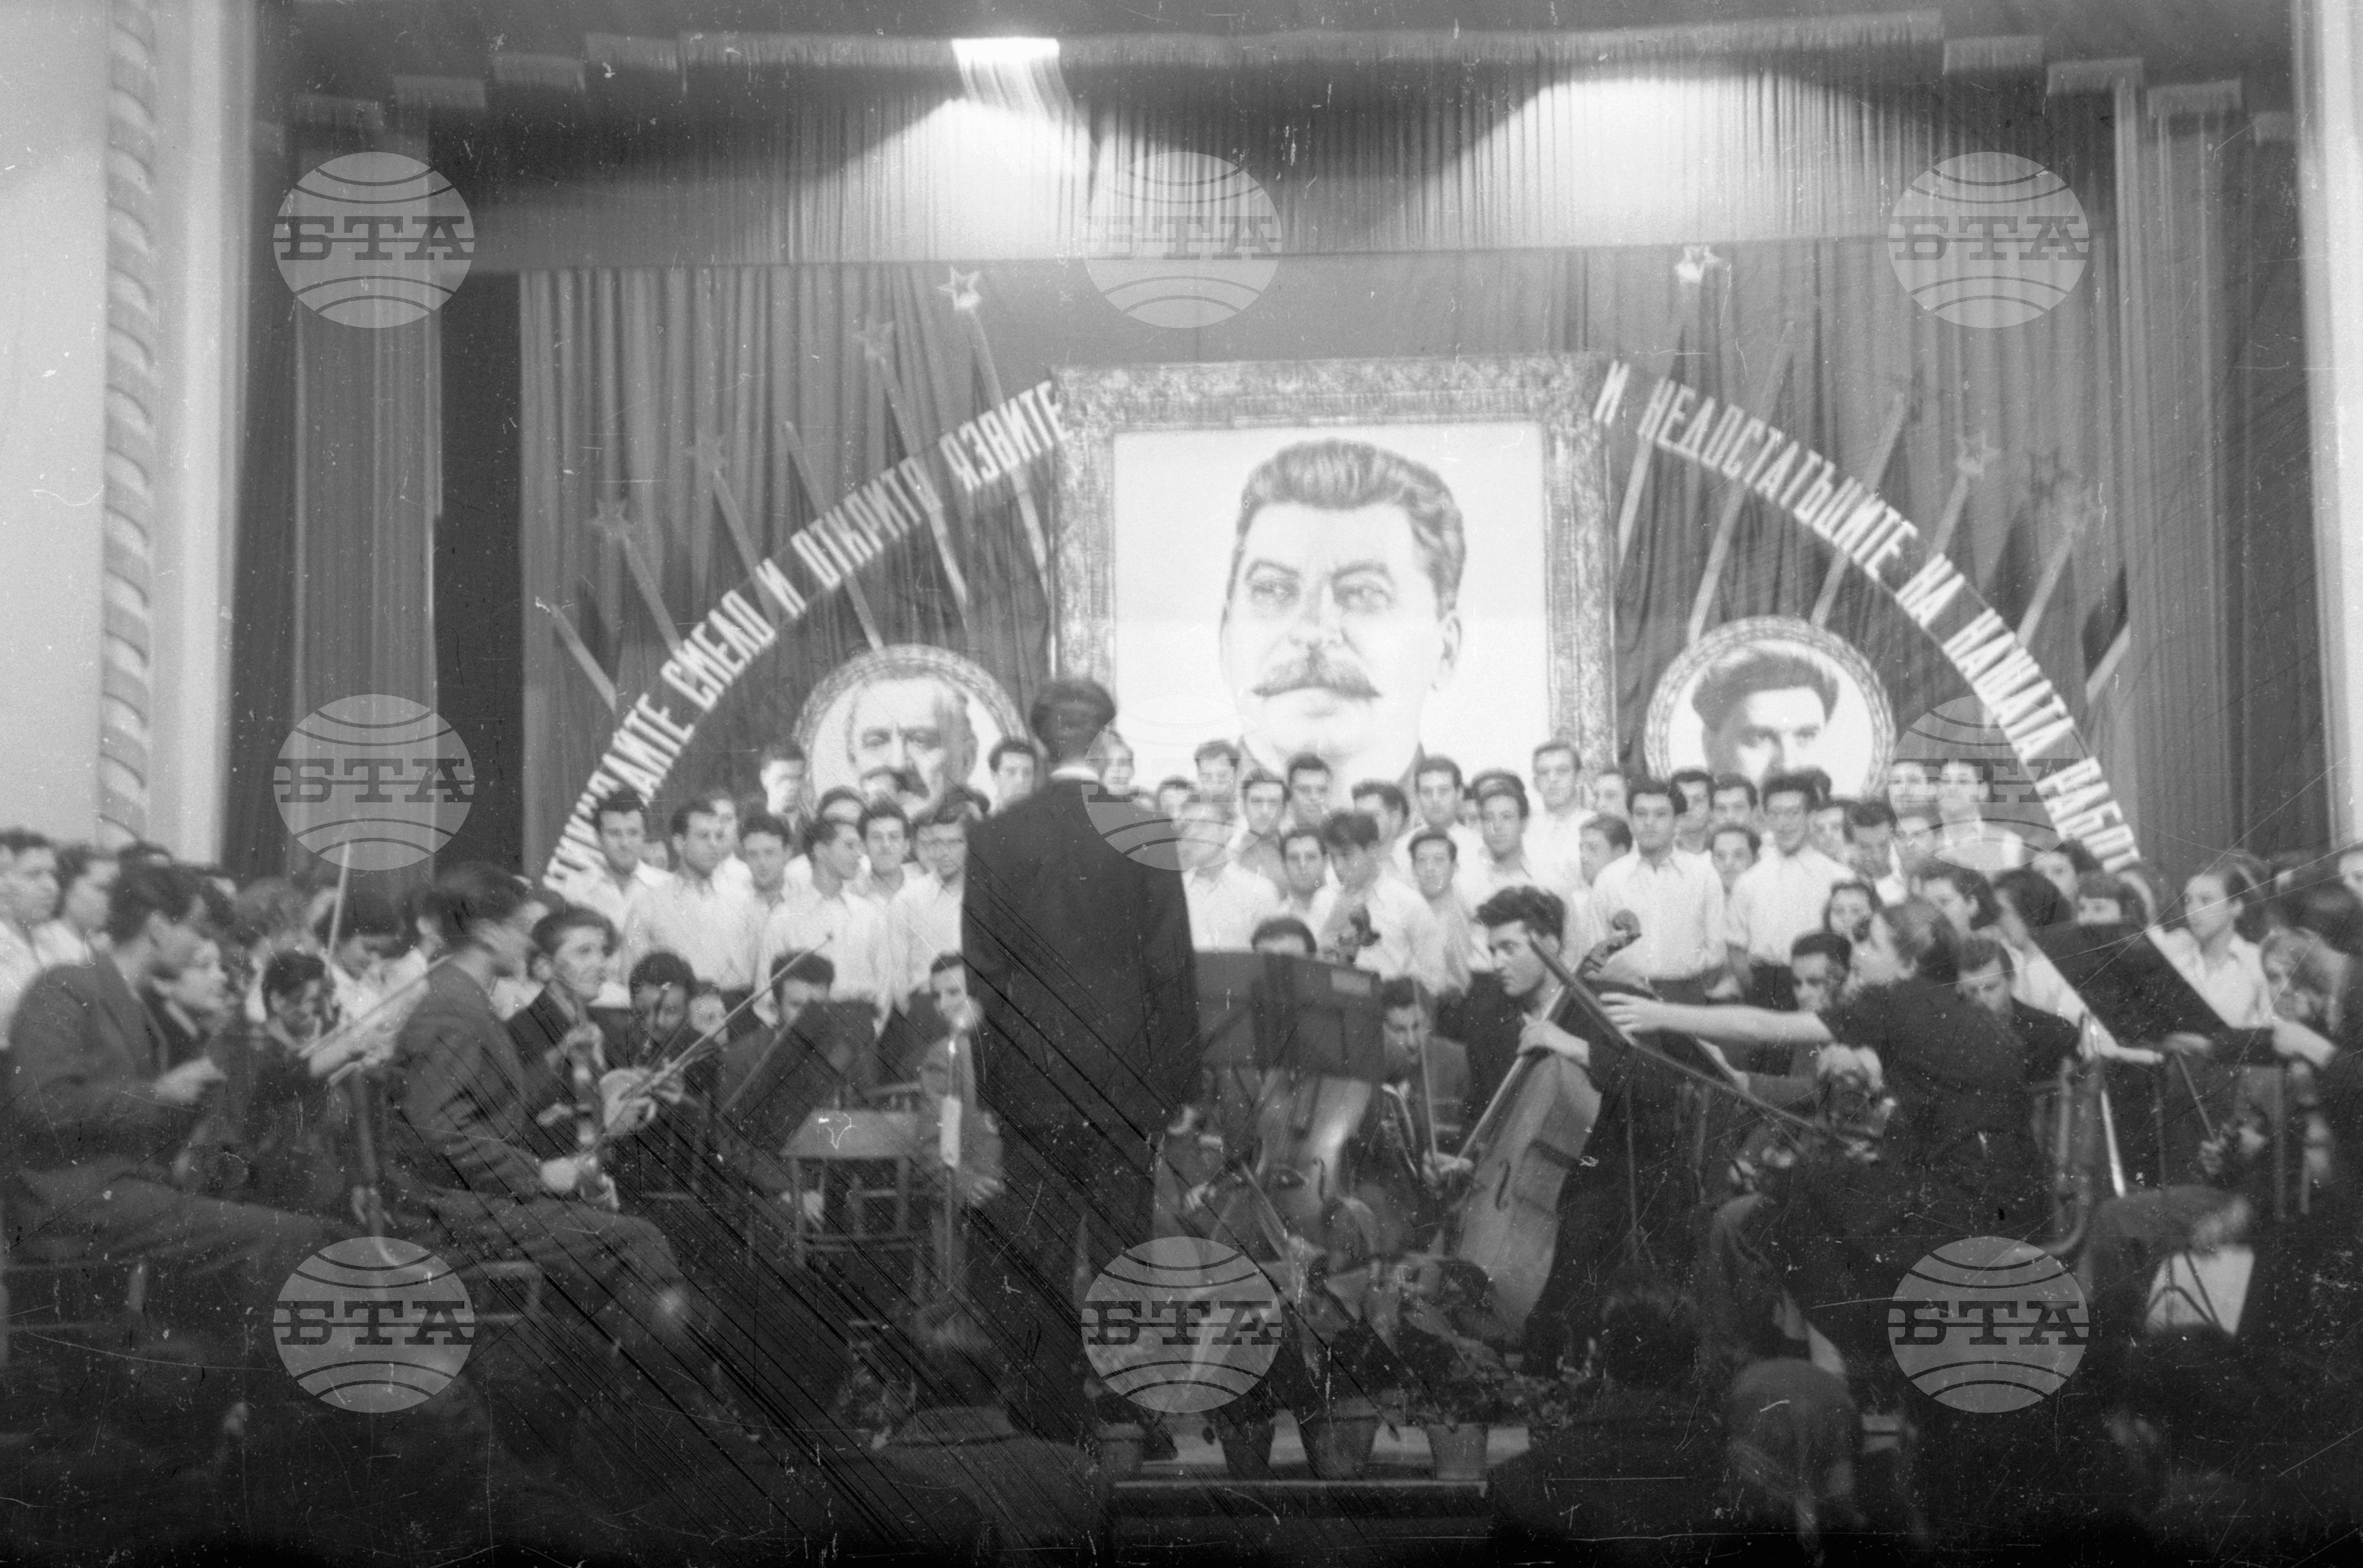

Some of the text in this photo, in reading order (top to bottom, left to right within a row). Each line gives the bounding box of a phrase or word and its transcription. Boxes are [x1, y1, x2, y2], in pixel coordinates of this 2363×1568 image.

[660, 590, 775, 709] СМЕЛО
[755, 558, 806, 619] И
[790, 456, 943, 591] ОТКРИТО
[939, 380, 1073, 493] ЯЗВИТЕ
[1593, 359, 1630, 426] И
[1636, 377, 1918, 582] НЕДОСТАТЪЦИТЕ
[1895, 553, 1965, 629] НА
[1942, 607, 2075, 766] НАШАТА
[2035, 756, 2140, 873] РАБОТ
